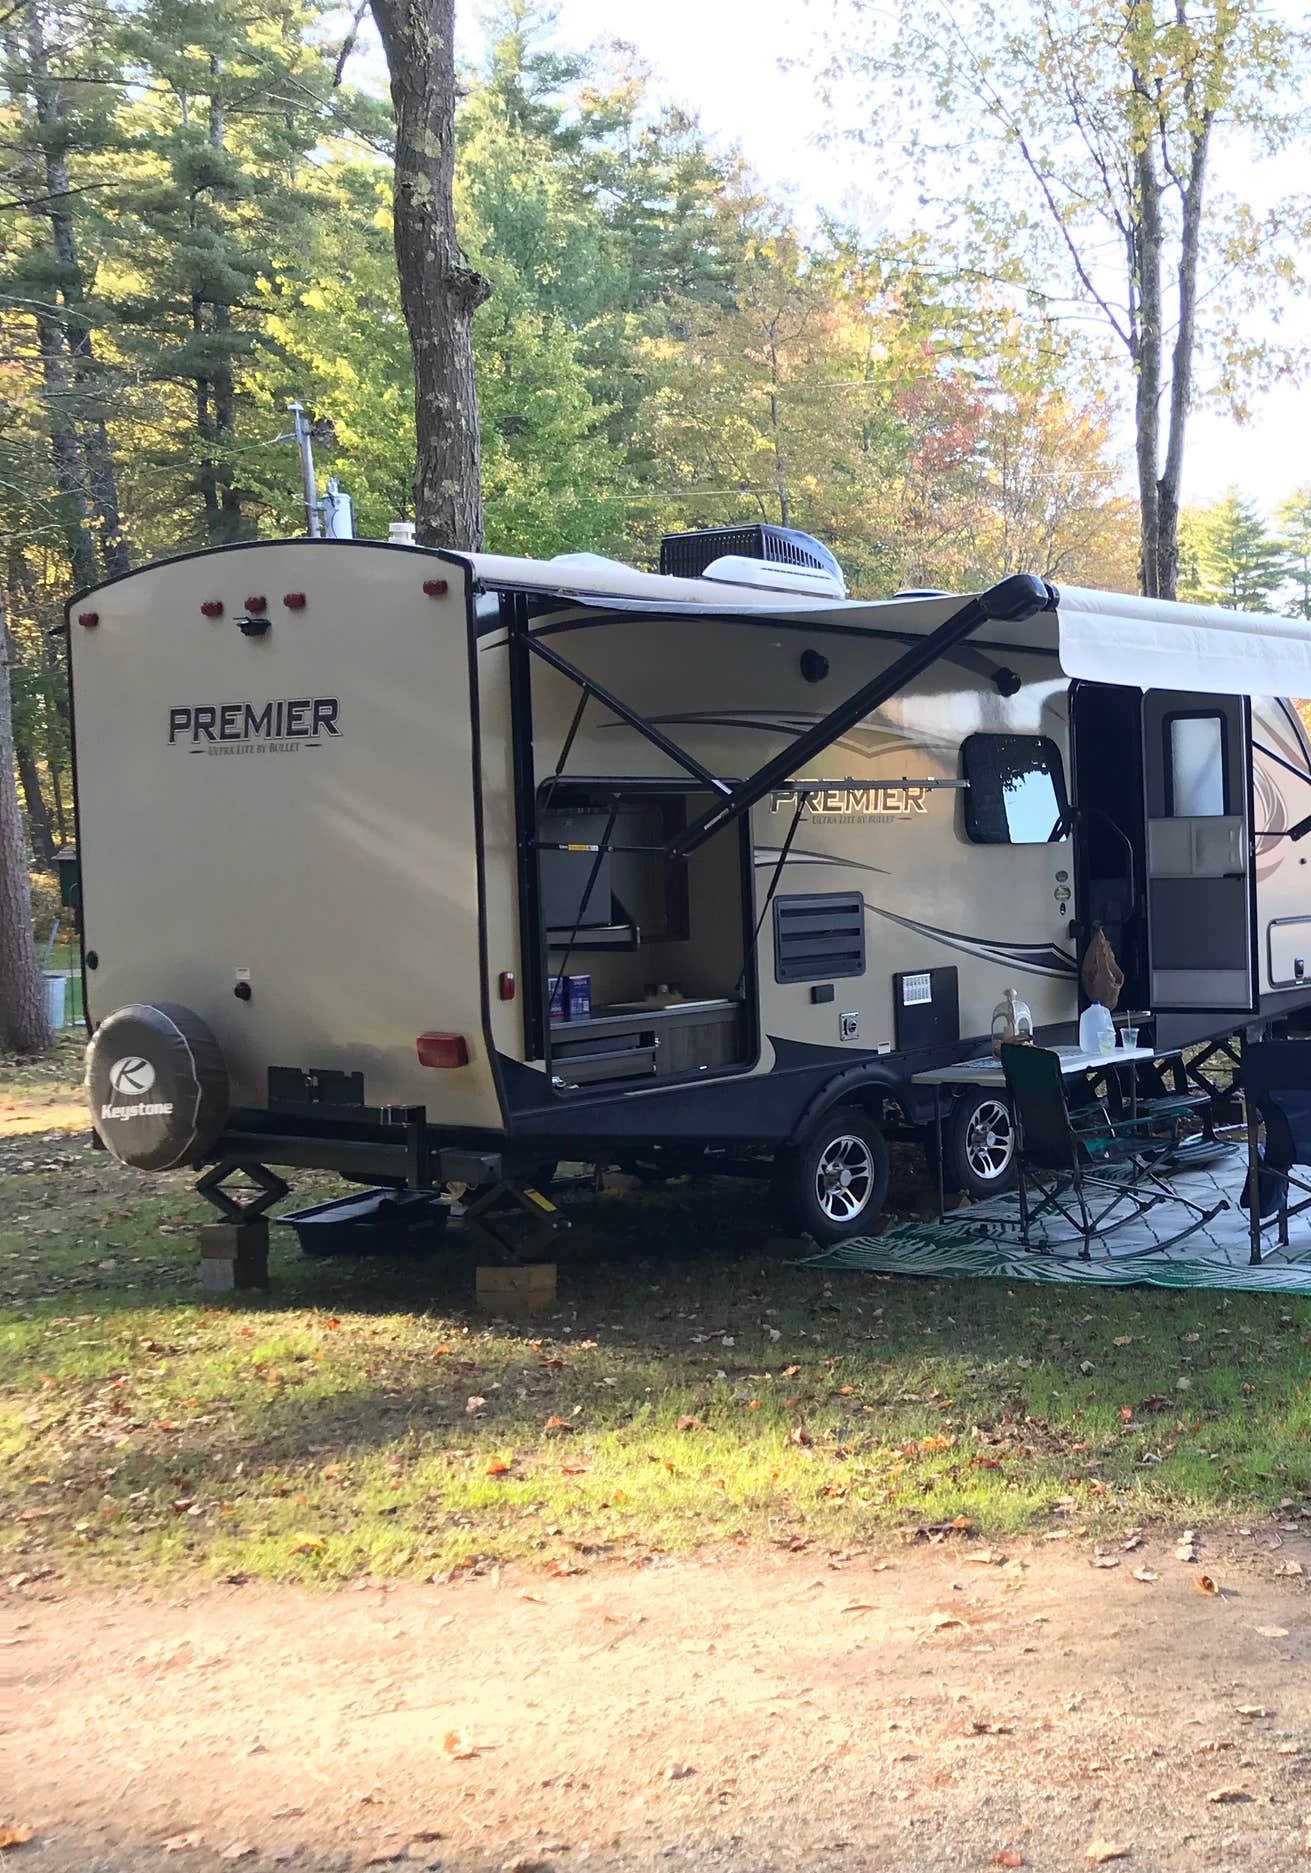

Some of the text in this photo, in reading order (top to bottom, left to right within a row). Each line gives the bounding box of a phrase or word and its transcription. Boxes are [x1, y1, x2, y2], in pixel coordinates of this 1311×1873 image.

[168, 697, 343, 745] PREMIER
[116, 1059, 148, 1090] K
[101, 1102, 174, 1121] Keystone
